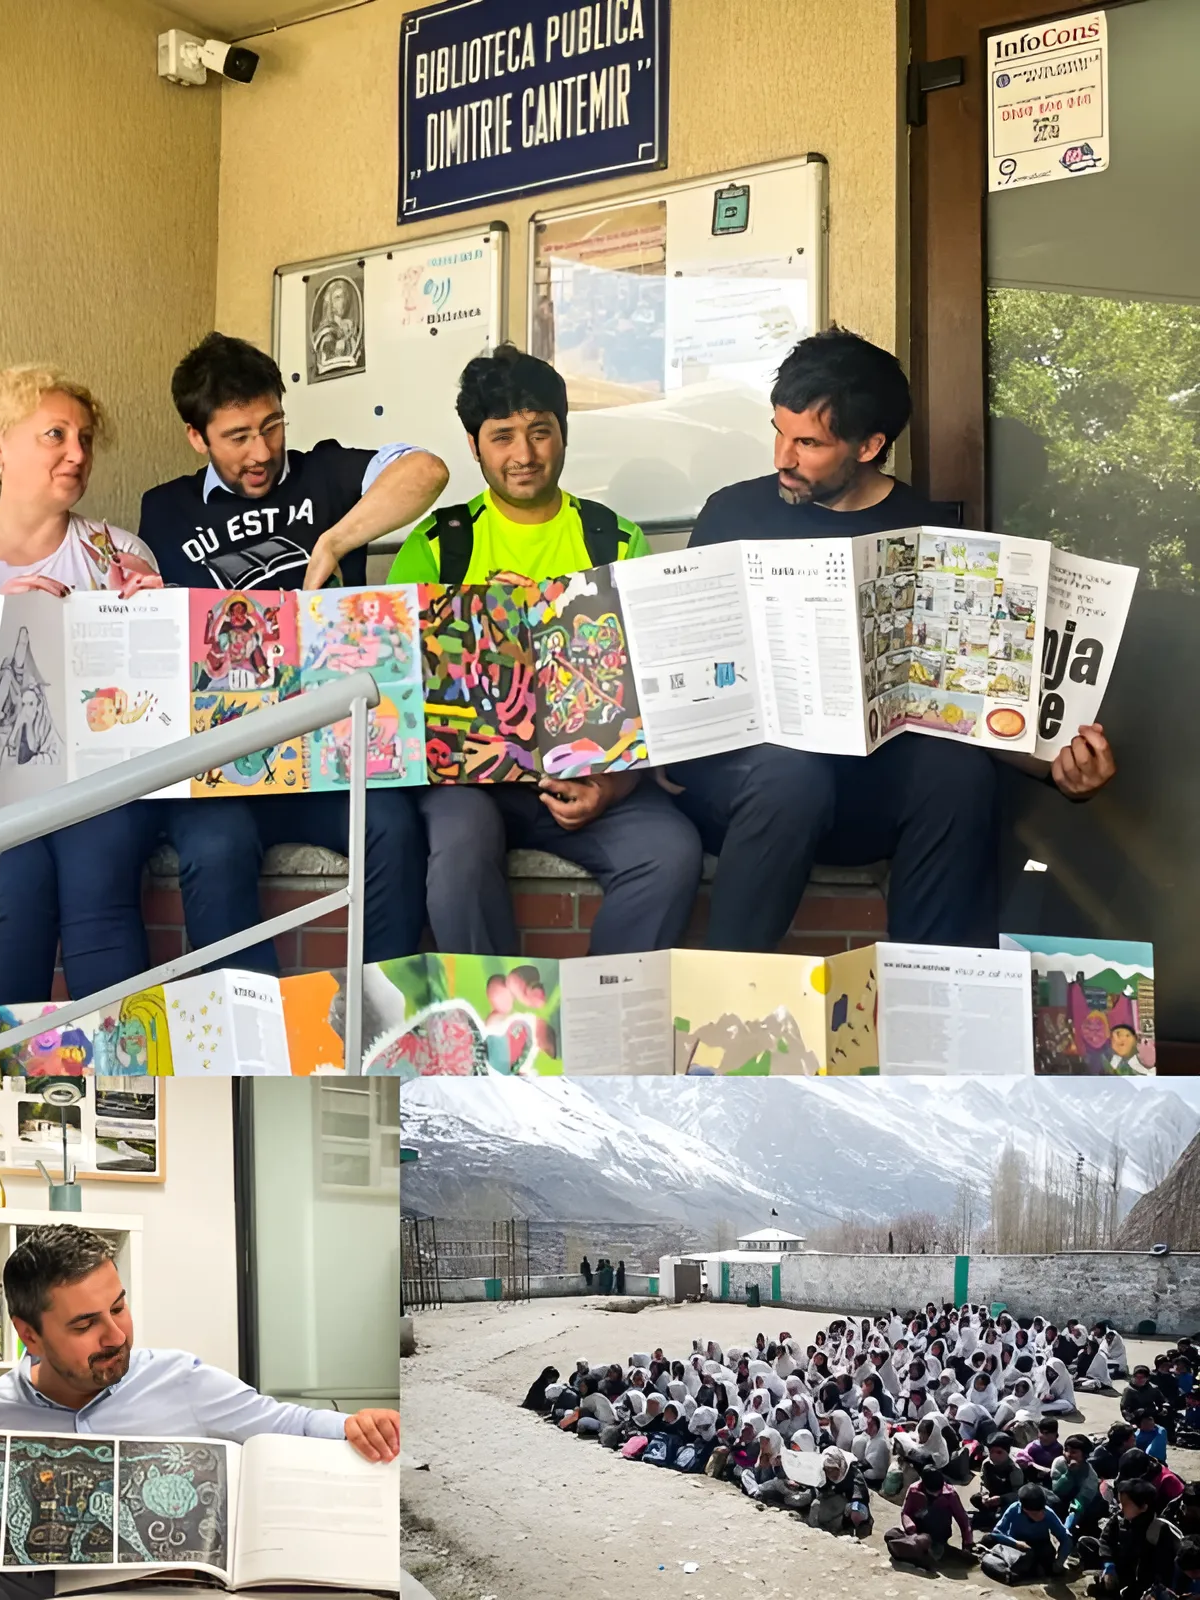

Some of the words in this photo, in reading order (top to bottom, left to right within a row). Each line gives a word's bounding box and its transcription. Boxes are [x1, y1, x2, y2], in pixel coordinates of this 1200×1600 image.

[415, 22, 536, 99] BIBLIOTECA
[995, 21, 1100, 59] InfoCons
[181, 526, 220, 564] OÙ
[226, 506, 280, 543] EST
